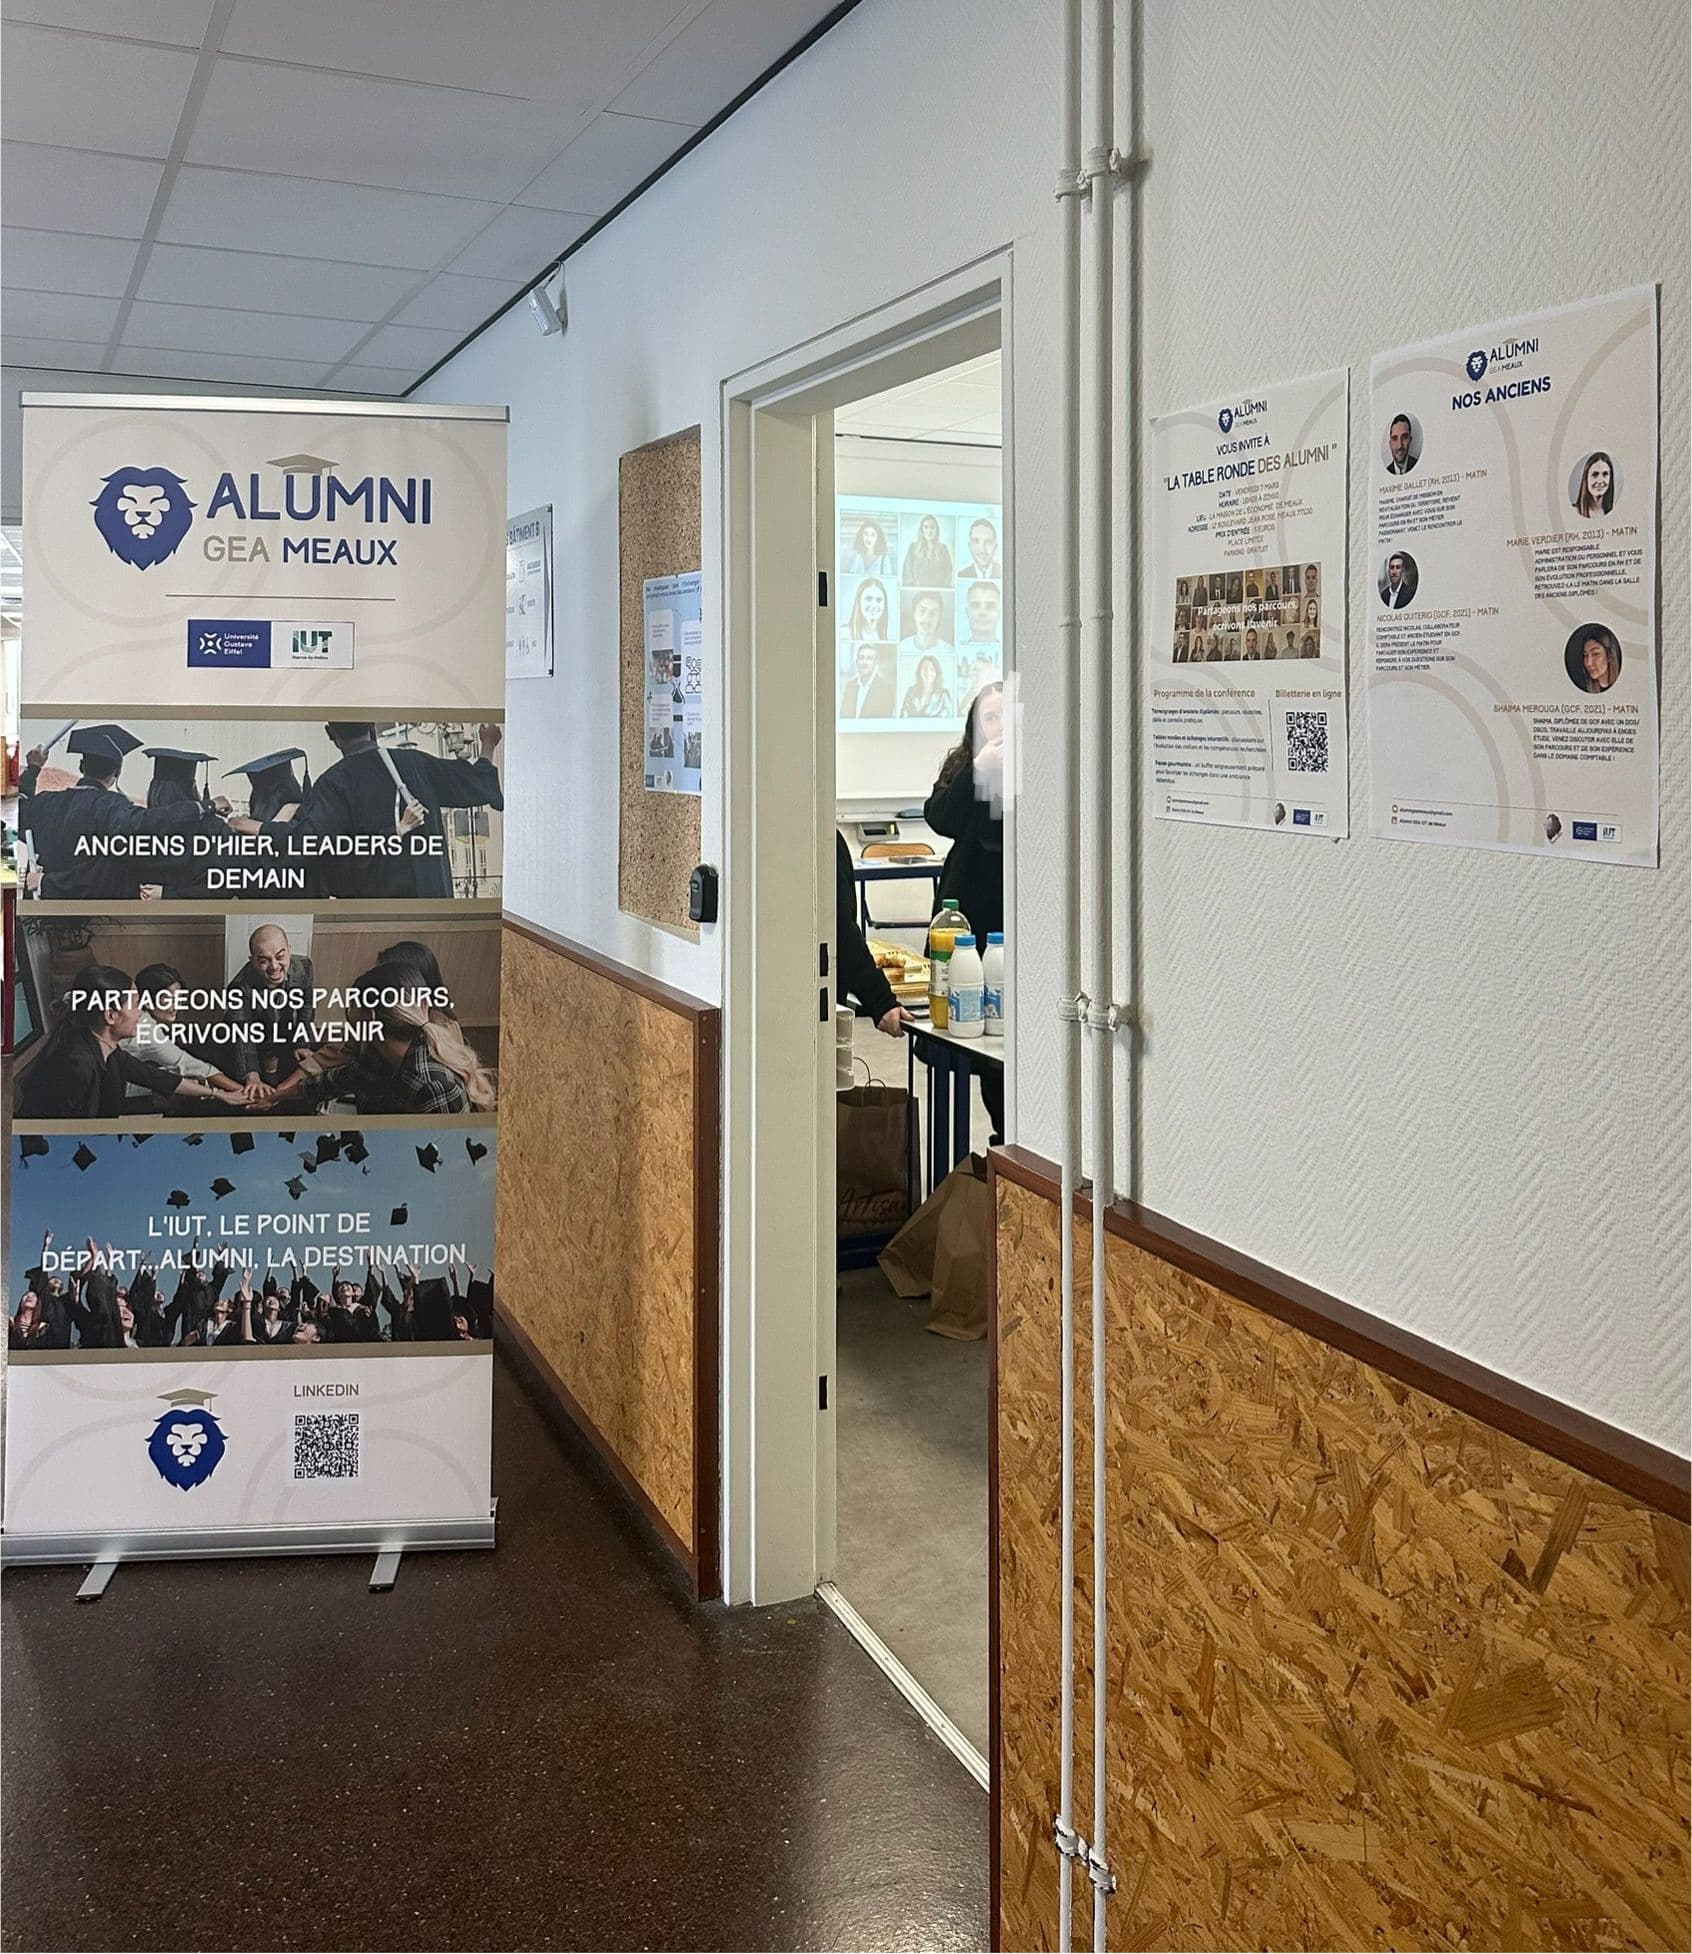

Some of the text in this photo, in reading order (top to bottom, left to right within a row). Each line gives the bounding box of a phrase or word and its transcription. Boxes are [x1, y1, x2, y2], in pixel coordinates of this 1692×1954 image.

[1490, 338, 1539, 363] ALUMNI
[1502, 360, 1523, 371] MEAUX
[1452, 376, 1551, 410] NOS ANCIENS
[1233, 401, 1267, 418] ALUMNI
[1216, 434, 1270, 456] VOUS INVITE À
[1182, 468, 1214, 488] TABLE
[1217, 460, 1255, 481] RONDE
[1257, 455, 1281, 474] DES
[1283, 445, 1329, 468] ALUMNI
[1379, 483, 1403, 494] MAXIME
[1404, 478, 1427, 490] GALLET
[1466, 469, 1487, 481] MATIN
[206, 473, 431, 524] ALUMNI
[1506, 536, 1529, 548] MARIE
[1531, 533, 1564, 545] VERDIER
[1612, 526, 1637, 537] MATIN
[203, 536, 398, 565] GEA MEAUX
[1627, 549, 1643, 557] VOUS
[1615, 577, 1623, 585] LA
[1197, 600, 1297, 617] Partageons nos parcours,
[1376, 613, 1403, 622] NICOLAS
[1477, 607, 1499, 616] MATIN
[292, 630, 333, 653] IUT
[1153, 688, 1256, 699] Programme de la conférence
[1275, 689, 1310, 698] Billetterie
[1323, 689, 1342, 700] ligne
[1494, 704, 1520, 713] SHAIMA
[1522, 705, 1560, 713] MEROUGA
[1612, 704, 1639, 713] MATIN
[74, 835, 443, 858] ANCIENS D'HIER, LEADERS DE
[207, 868, 305, 889] DEMAIN
[71, 987, 455, 1010] PARTAGEONS NOS PARCOURS,
[137, 1018, 385, 1045] ÉCRIVONS L'AVENIR
[149, 1212, 371, 1238] L'IUT, LE POINT DE
[42, 1243, 466, 1272] DÉPART...ALUMNI, LA DESTINATION
[294, 1383, 359, 1397] LINKEDIN
